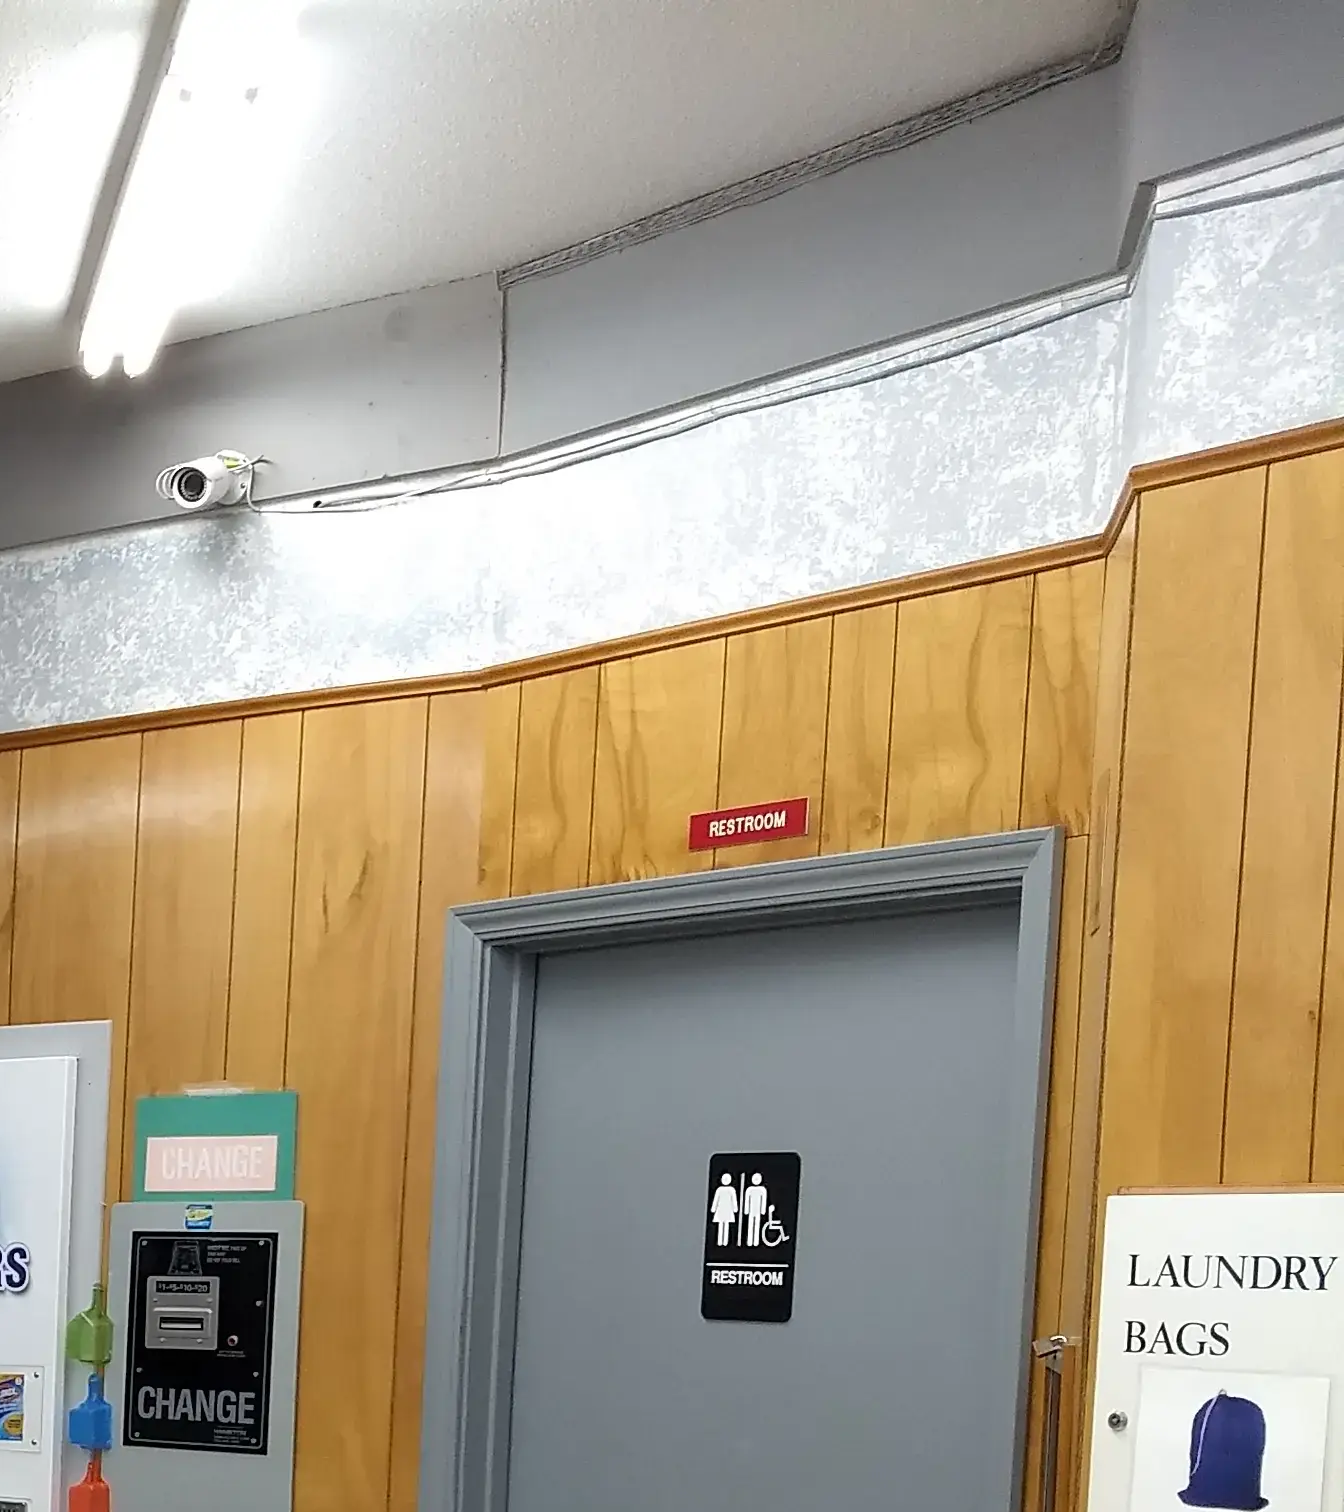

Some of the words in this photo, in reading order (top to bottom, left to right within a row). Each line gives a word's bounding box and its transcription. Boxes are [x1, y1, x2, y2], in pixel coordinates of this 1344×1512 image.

[709, 811, 786, 837] RESTROOM
[162, 1145, 263, 1180] CHANGE
[710, 1270, 784, 1286] RESTROOM
[1127, 1254, 1338, 1291] LAUNDRY
[1123, 1320, 1230, 1356] BAGS
[138, 1386, 256, 1424] CHANGE
